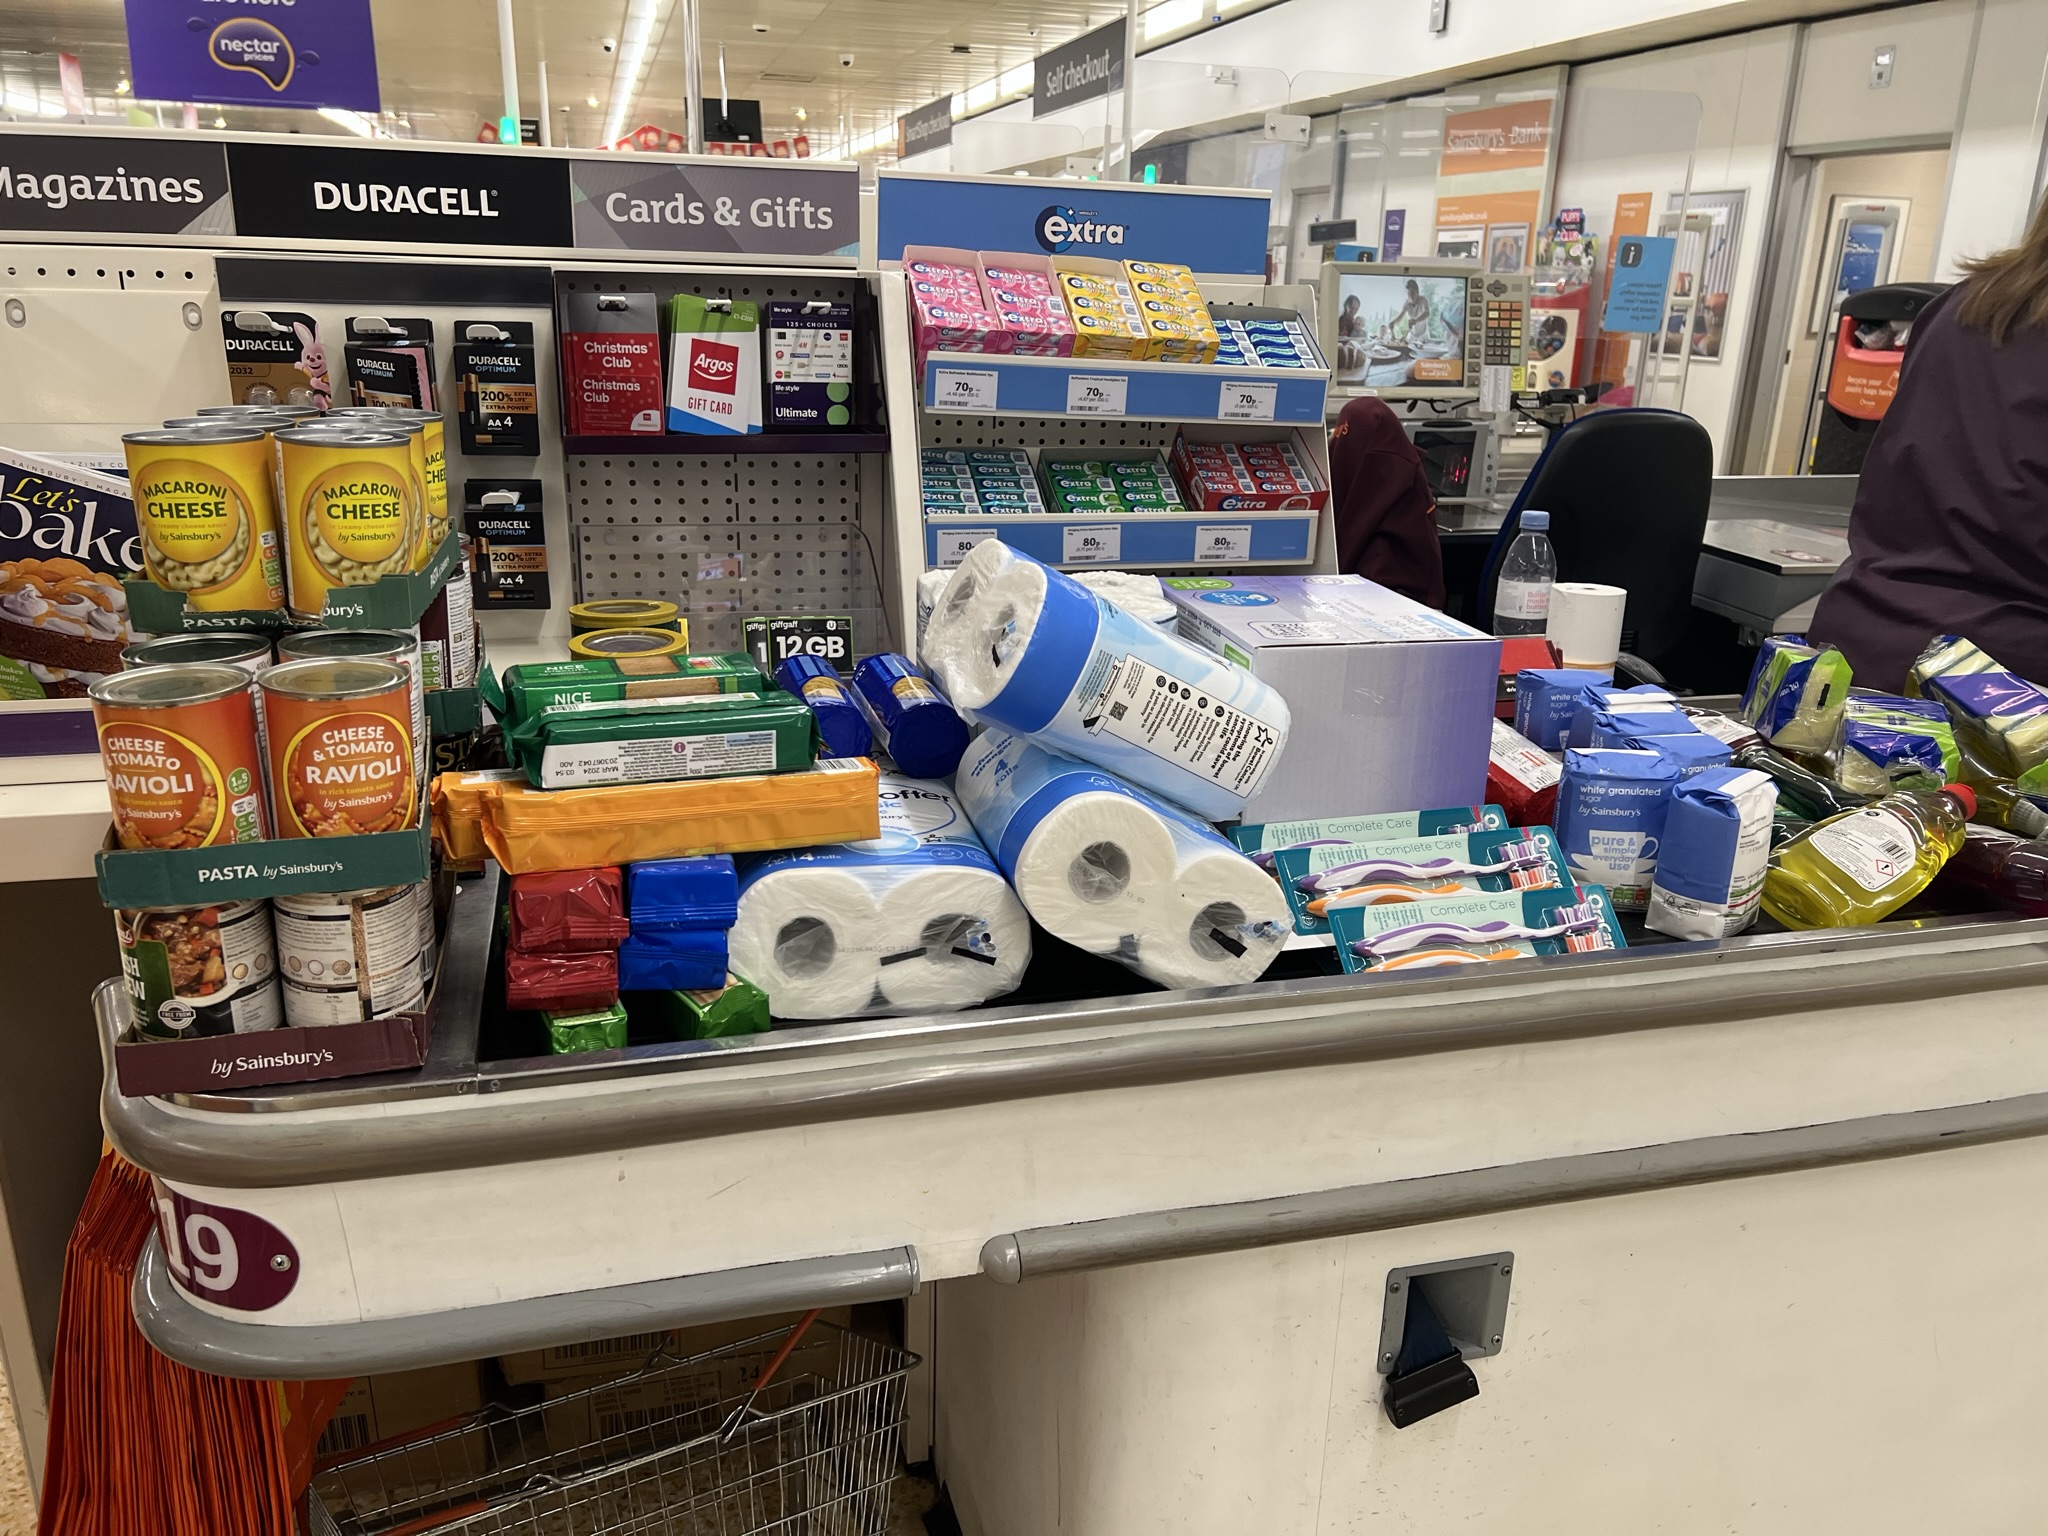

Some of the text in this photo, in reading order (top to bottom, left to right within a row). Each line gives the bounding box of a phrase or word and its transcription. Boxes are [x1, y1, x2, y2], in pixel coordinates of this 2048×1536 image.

[221, 38, 280, 54] nectar
[243, 53, 275, 62] prices
[1046, 49, 1109, 98] Self checkout
[1510, 122, 1541, 146] Bank
[605, 192, 833, 230] Cards & Gifts
[1561, 211, 1581, 222] PUPPY
[1043, 215, 1125, 246] extra
[225, 339, 294, 351] DURACELL
[583, 341, 648, 355] Christmas
[357, 358, 395, 371] DURACELL
[468, 355, 521, 366] DURACELL
[602, 356, 632, 369] Club
[694, 353, 734, 374] Argos
[230, 367, 254, 375] 2032
[361, 368, 393, 378] OPTIMUM
[475, 365, 516, 373] OPTIMUM
[582, 379, 641, 392] Christmas
[955, 382, 974, 393] 70p
[481, 391, 513, 402] 200%
[583, 392, 610, 403] Club
[1086, 387, 1104, 398] 70p
[688, 396, 733, 415] GIFT CARD
[1240, 394, 1256, 405] 70p
[775, 407, 818, 418] Ultimate
[487, 416, 513, 427] AA 4
[12, 460, 89, 487] SAINSBURY'S
[979, 466, 1010, 474] extra
[1051, 463, 1082, 471] extra
[1116, 466, 1147, 474] extra
[1255, 470, 1286, 478] extra
[1060, 479, 1092, 487] extra
[1261, 483, 1292, 491] extra
[6, 477, 80, 513] Let's
[143, 480, 228, 500] MACARONI
[322, 481, 402, 501] MACARONI
[1066, 494, 1098, 502] extra
[1125, 493, 1157, 501] extra
[147, 501, 228, 520] CHEESE
[1223, 498, 1266, 510] extra
[326, 502, 401, 520] CHEESE
[478, 520, 531, 529] DURACELL
[159, 530, 222, 543] by Sainsbury's
[337, 530, 396, 543] by Sainsbury's
[1083, 537, 1100, 547] 80p
[1214, 537, 1231, 547] 80p
[492, 552, 525, 562] 200%
[499, 574, 524, 585] AA 4
[183, 617, 256, 630] PASTA
[770, 619, 798, 631] giffgaff
[546, 663, 584, 672] NICE
[554, 691, 592, 704] NICE
[1218, 710, 1235, 739] your life
[322, 725, 385, 744] CHEESE
[1227, 717, 1248, 751] symptoms
[107, 738, 166, 754] CHEESE
[1210, 714, 1242, 770] cancer could save
[1231, 720, 1255, 762] Knowing the
[313, 740, 395, 762] & TOMATO
[1248, 746, 1261, 766] Bowel
[112, 753, 181, 771] TOMATO
[975, 741, 1012, 776] stronger
[1249, 753, 1263, 776] partnership
[306, 754, 402, 785] RAVIOLI
[994, 758, 1009, 776] 4
[1212, 758, 1228, 780] bowel
[996, 764, 1019, 787] rolls
[1237, 764, 1251, 785] Cancer
[106, 769, 194, 795] RAVIOLI
[328, 787, 345, 796] rich
[346, 784, 375, 795] tomato
[375, 780, 395, 791] sauce
[1579, 785, 1661, 798] white granulated
[324, 791, 394, 810] by Sainsbury's
[1579, 794, 1602, 804] sugar
[127, 808, 183, 820] Sainsbury's
[1578, 806, 1641, 818] by Sainsbury's
[1327, 817, 1413, 835] Complete Care
[1591, 835, 1636, 847] pure &
[1375, 839, 1463, 858] Complete Care
[1603, 845, 1637, 856] simple
[800, 851, 814, 861] 4
[1592, 853, 1636, 865] everyday
[198, 861, 343, 884] PASTA by Sainsbury's
[1609, 861, 1631, 872] use
[1430, 899, 1517, 918] Complete Care
[211, 1048, 334, 1079] by Sainsbury's
[159, 1198, 239, 1291] 19
